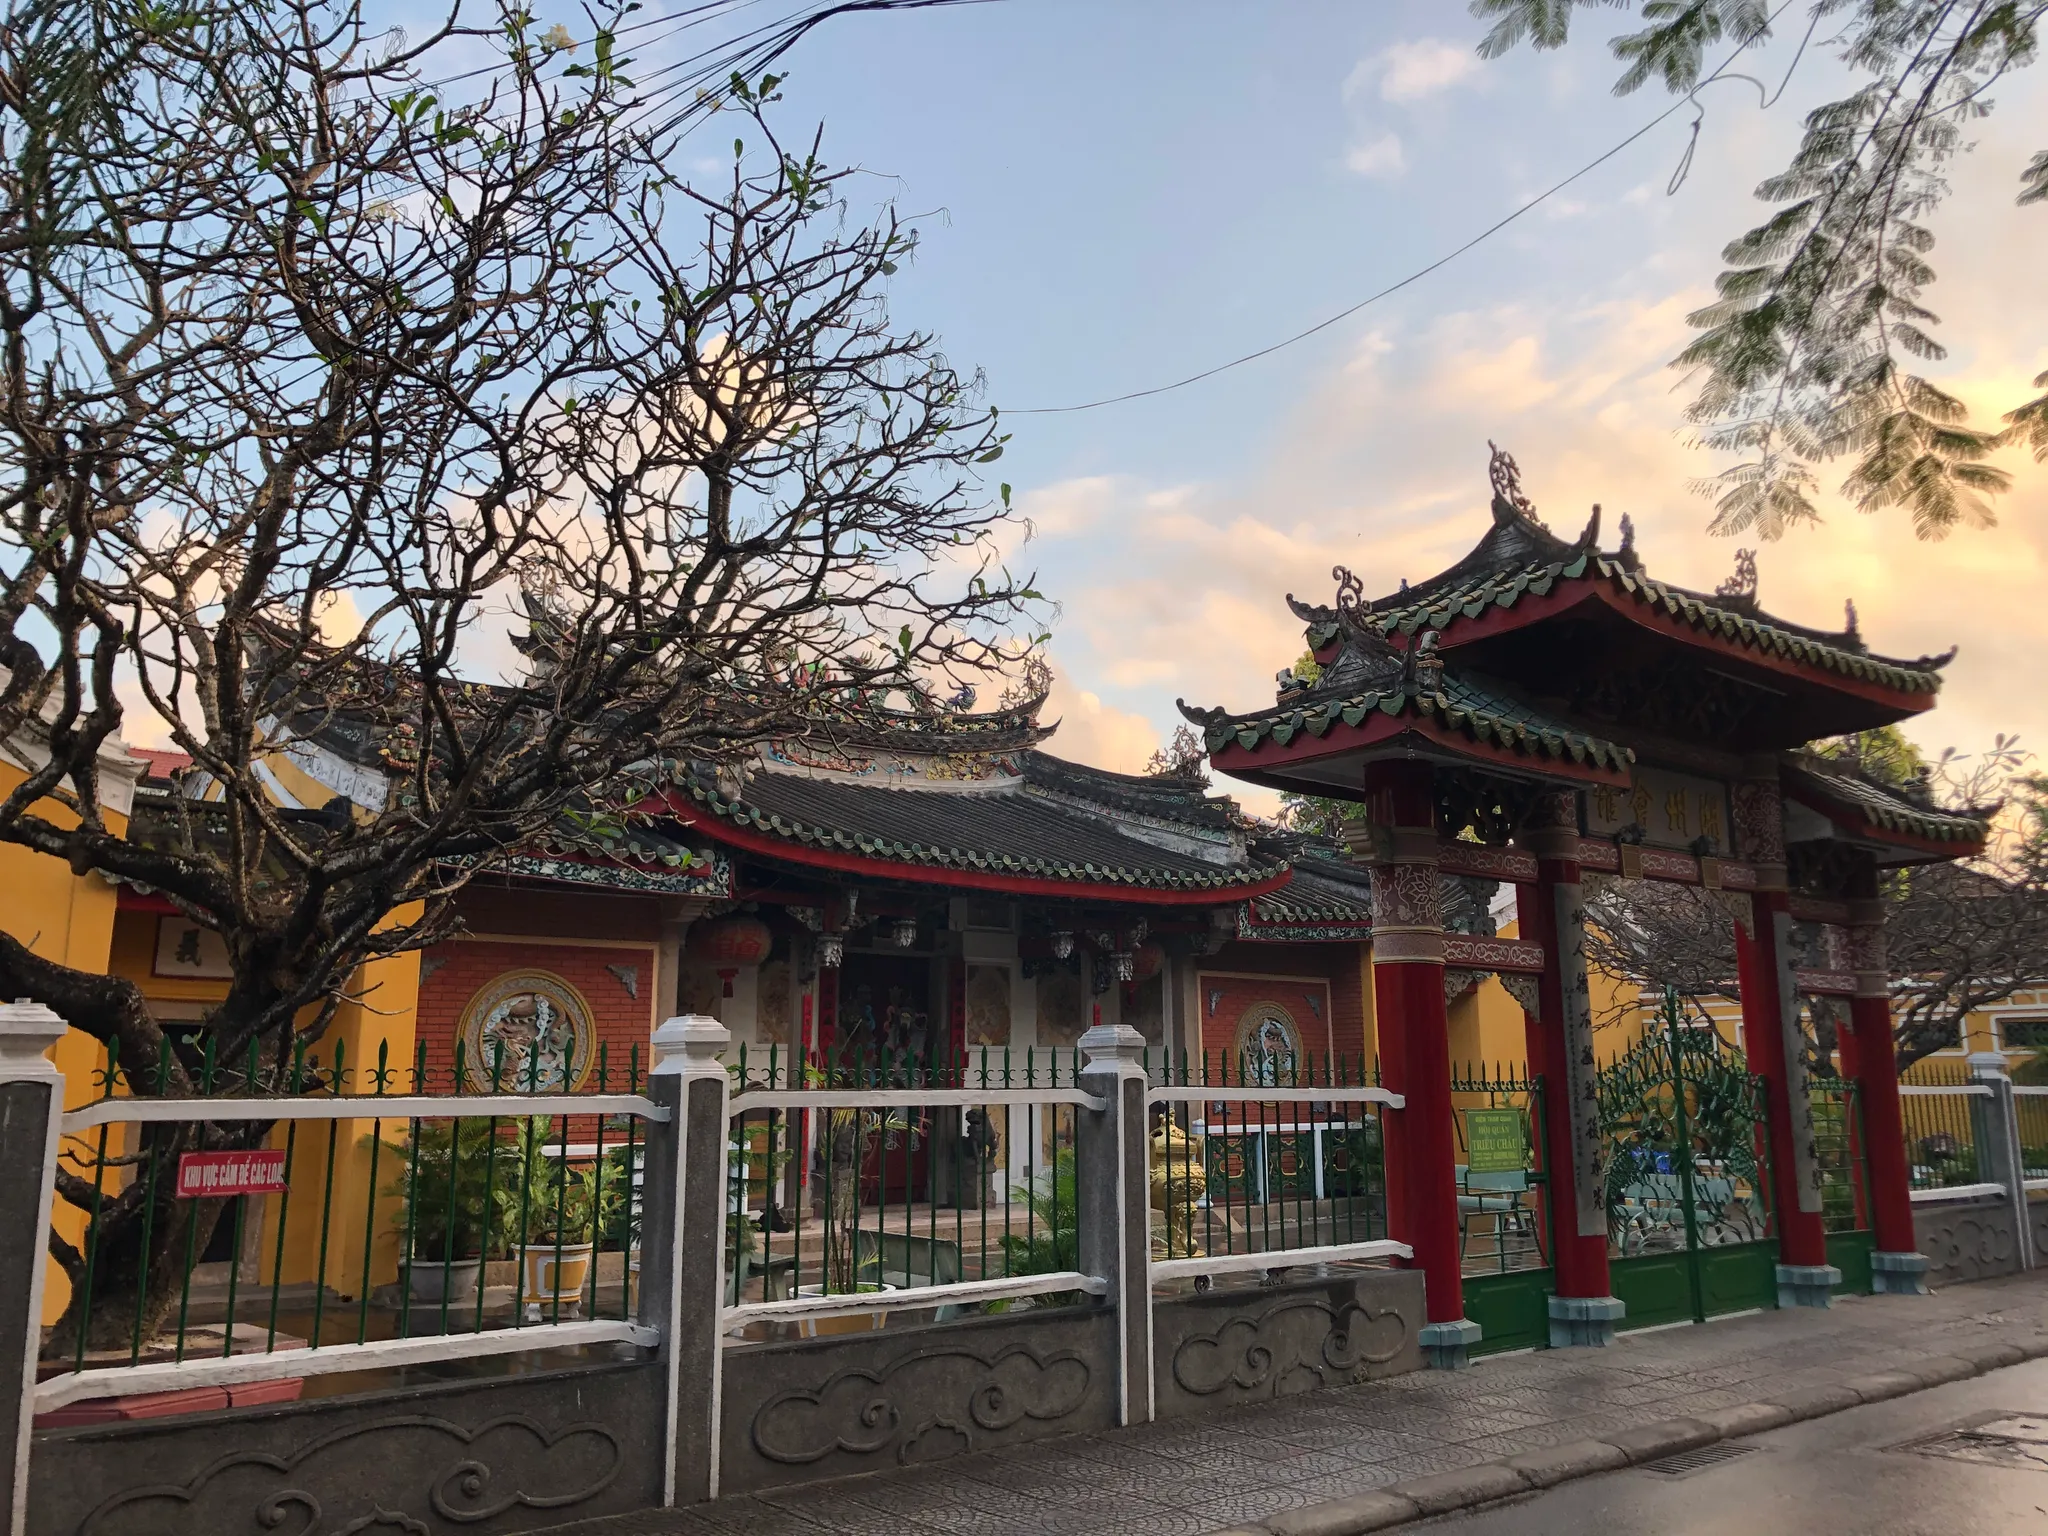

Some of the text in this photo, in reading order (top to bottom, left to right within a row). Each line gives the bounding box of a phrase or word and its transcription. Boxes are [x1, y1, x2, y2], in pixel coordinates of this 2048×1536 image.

[184, 1165, 202, 1188] KHU
[202, 1162, 219, 1192] VỰC
[219, 1156, 238, 1187] CẤM
[250, 1158, 267, 1185] CÁC
